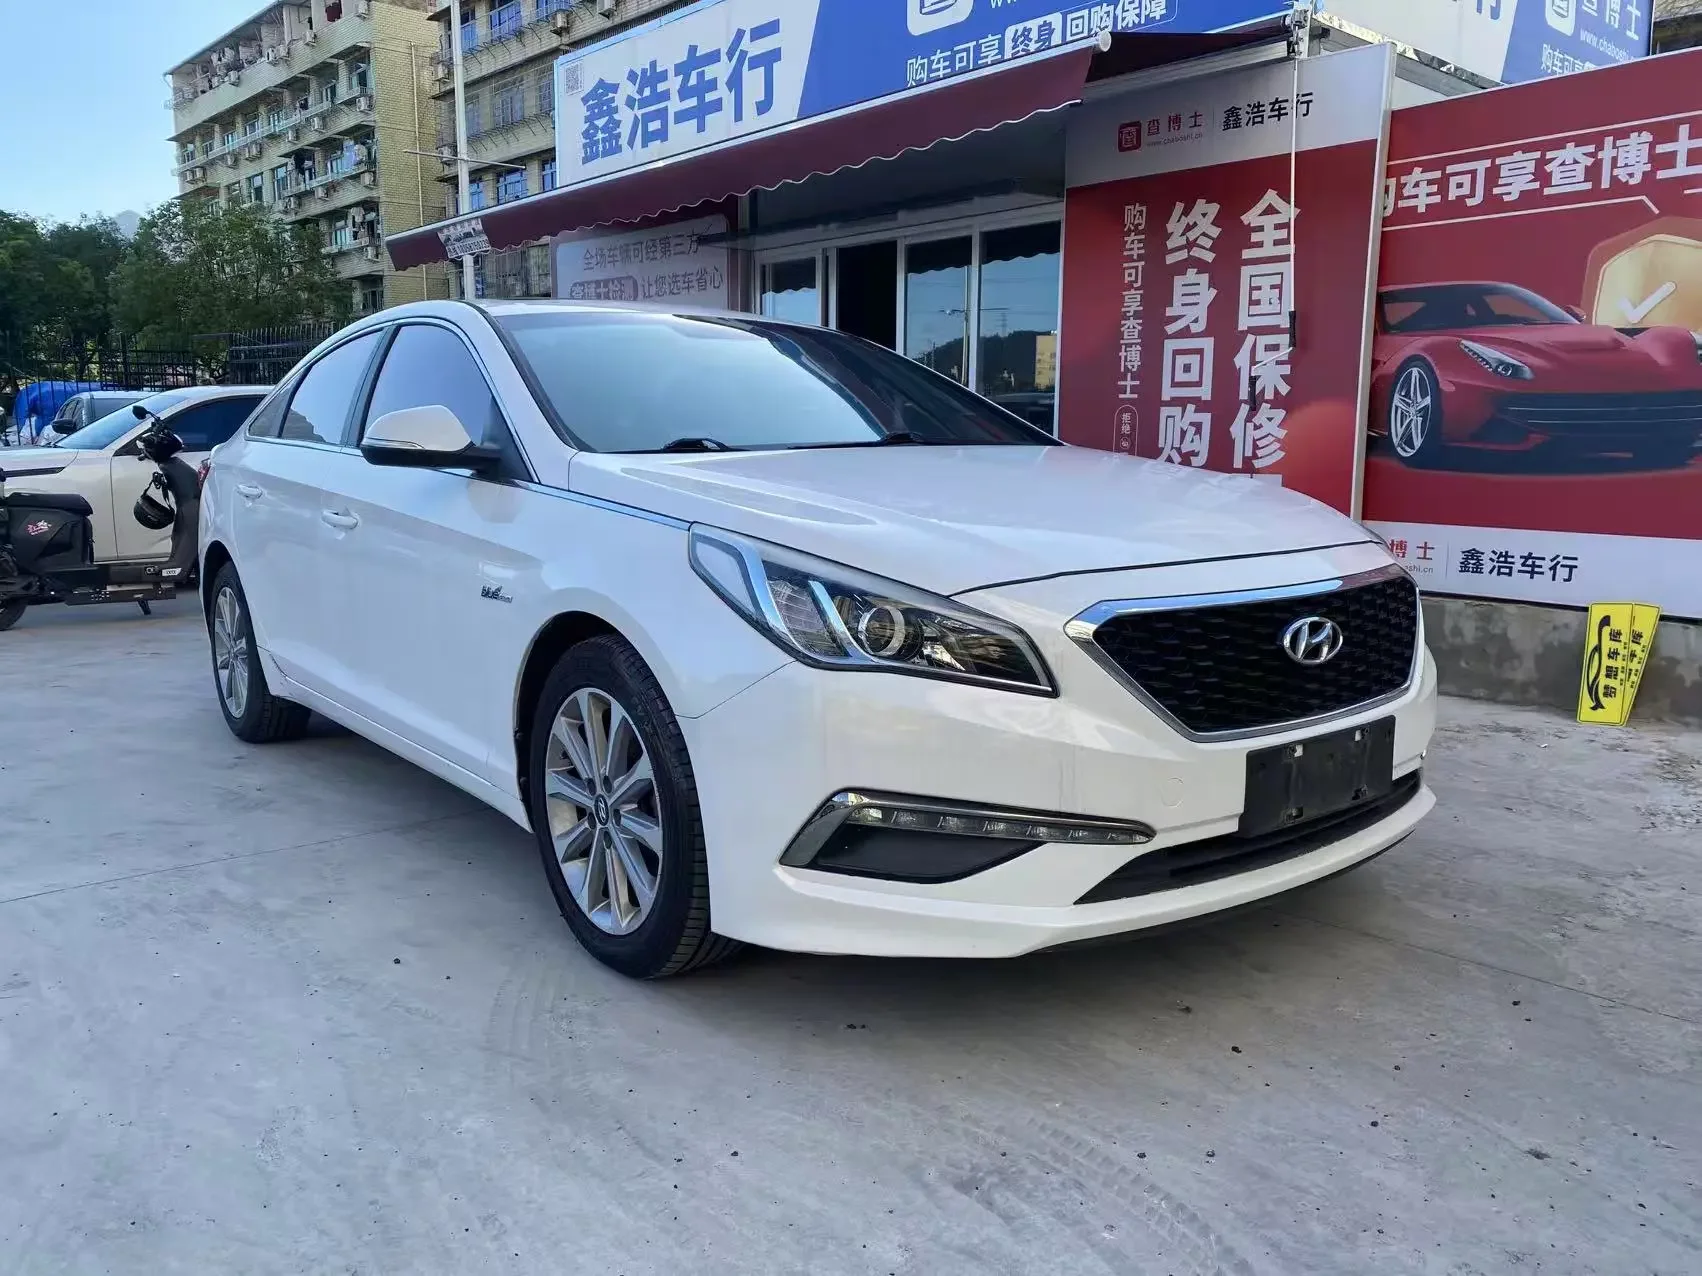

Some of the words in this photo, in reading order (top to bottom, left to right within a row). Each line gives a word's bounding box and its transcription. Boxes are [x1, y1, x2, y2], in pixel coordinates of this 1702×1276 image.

[581, 18, 782, 165] 鑫浩车行
[1147, 111, 1203, 136] 查博士
[1222, 92, 1314, 131] 鑫浩车行
[1118, 203, 1147, 399] 购车可享查博士
[1157, 199, 1222, 467] 终身回购
[1229, 188, 1300, 487] 全国保修
[1458, 547, 1579, 583] 鑫浩车行
